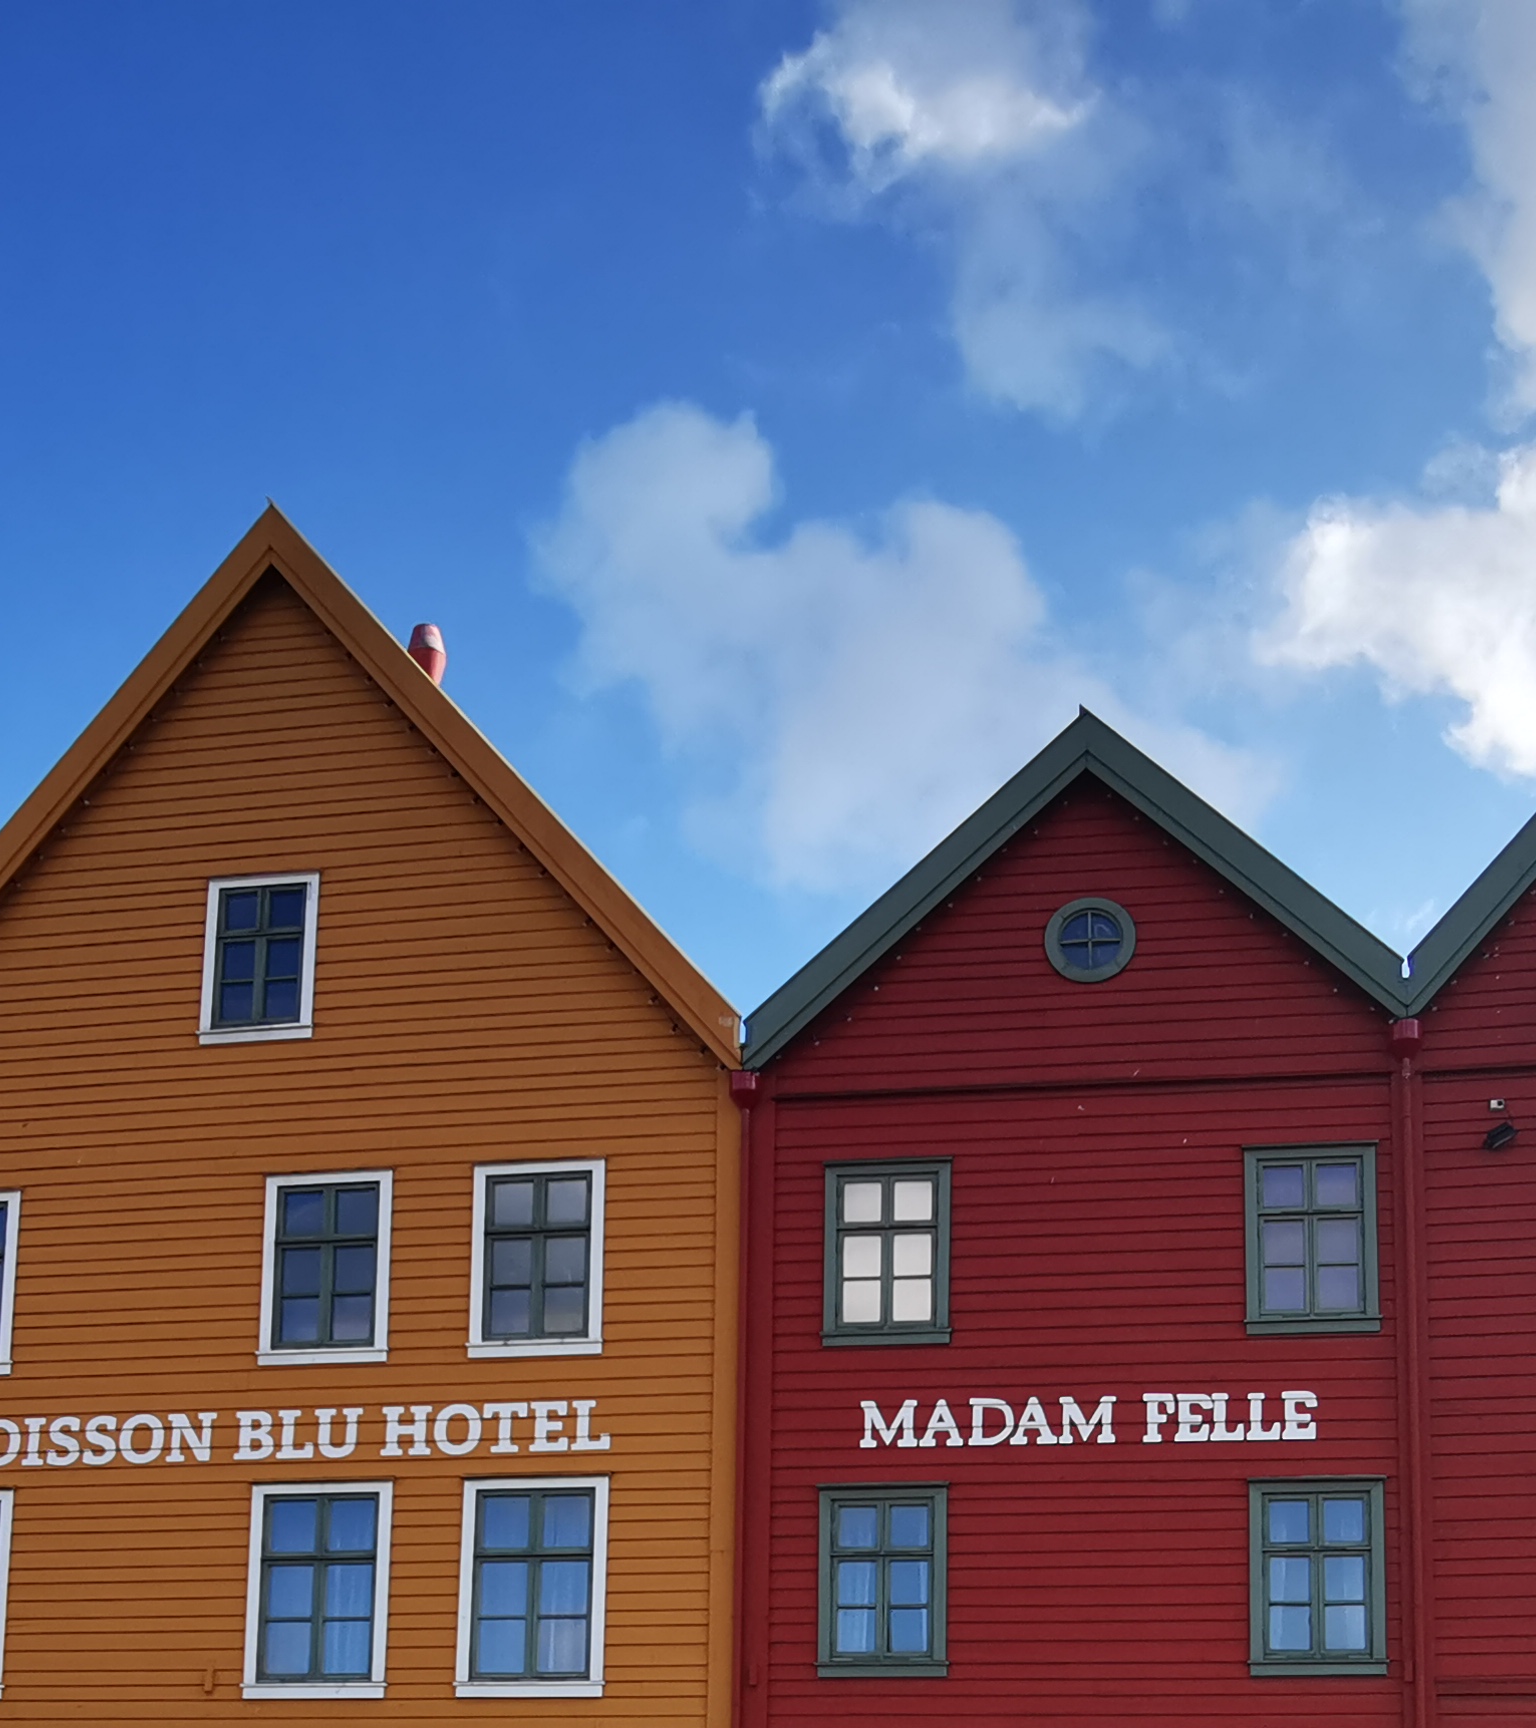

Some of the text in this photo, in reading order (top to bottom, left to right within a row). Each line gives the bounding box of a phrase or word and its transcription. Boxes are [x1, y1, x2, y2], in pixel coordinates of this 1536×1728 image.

[233, 1408, 364, 1461] BLU
[380, 1400, 611, 1457] HOTEL
[859, 1390, 1318, 1448] MADAM FELLE
